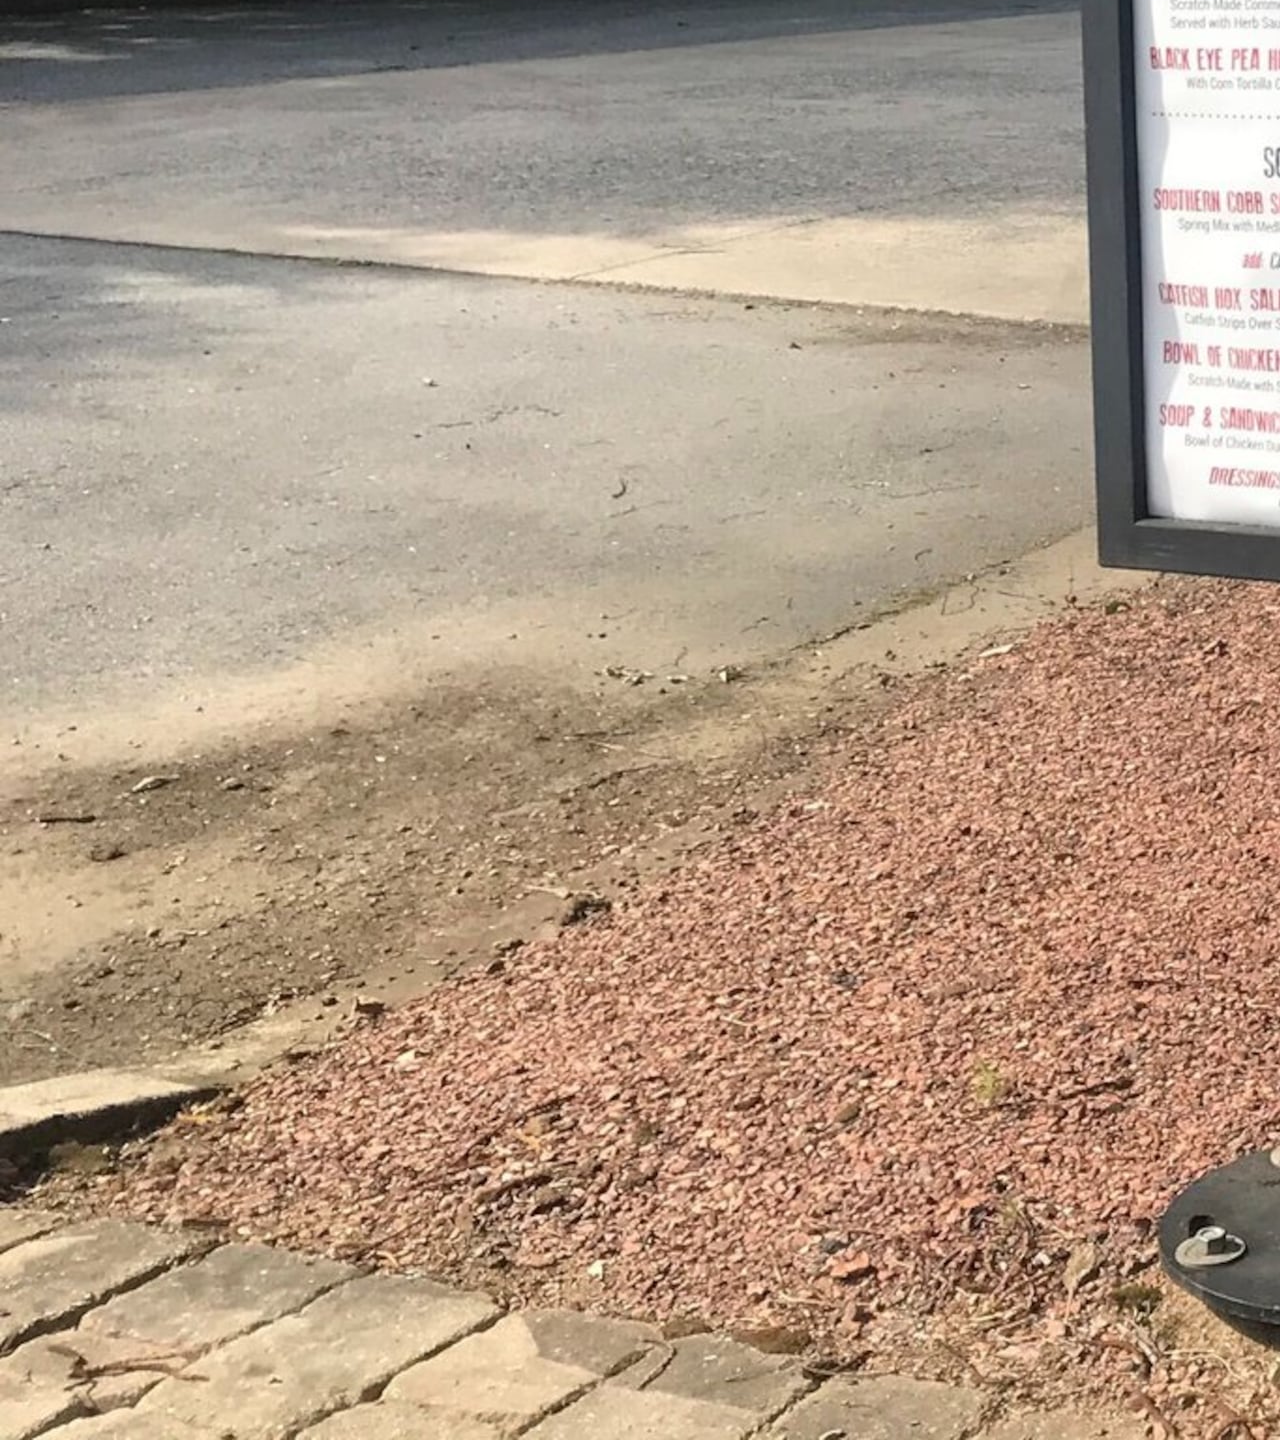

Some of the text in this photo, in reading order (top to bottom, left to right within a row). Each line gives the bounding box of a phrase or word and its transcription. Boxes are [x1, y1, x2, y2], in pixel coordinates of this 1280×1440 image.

[1150, 48, 1189, 70] BLACK
[1197, 48, 1222, 71] EYE
[1232, 48, 1260, 71] PEA
[1154, 189, 1221, 213] SOUTHERN
[1227, 191, 1263, 214] COBB
[1159, 283, 1208, 307] CATFISH
[1163, 342, 1200, 365] BOWL
